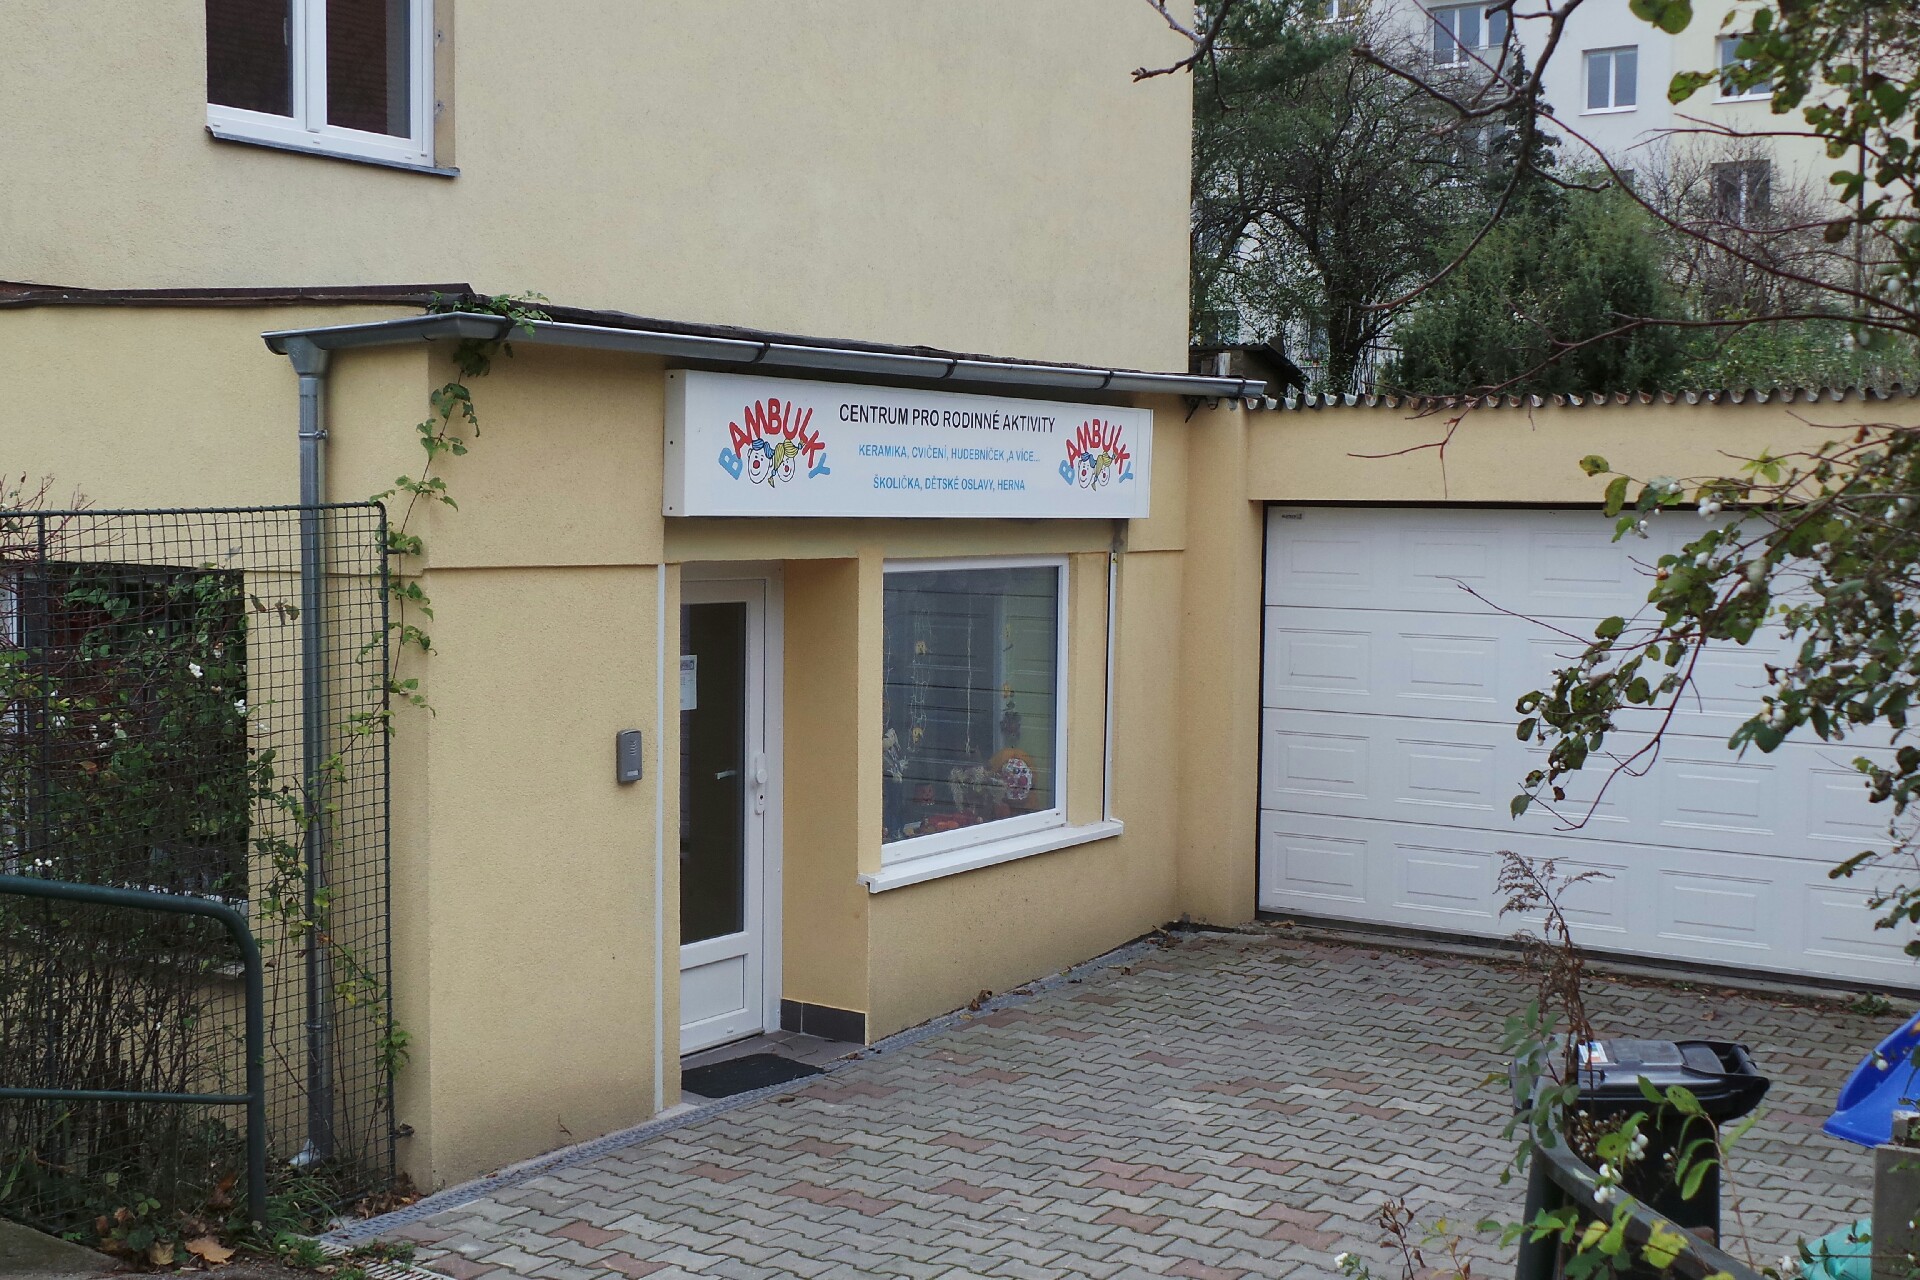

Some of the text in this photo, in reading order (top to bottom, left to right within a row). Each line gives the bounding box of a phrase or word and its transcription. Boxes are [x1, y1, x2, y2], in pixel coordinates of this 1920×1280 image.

[839, 403, 1056, 433] CENTRUM PRO RODINNÉ AKTIVITY
[718, 398, 831, 480] BAMBULKY
[858, 444, 910, 460] KERAMIKA,
[911, 444, 949, 461] CVIČENÍ,
[951, 447, 1005, 461] HUDEBNÍČEK
[1058, 418, 1134, 486] BAMBULKY
[873, 474, 1026, 492] ŠKOLIČKA, DĚTSKÉ OSLAVY, HERNA
